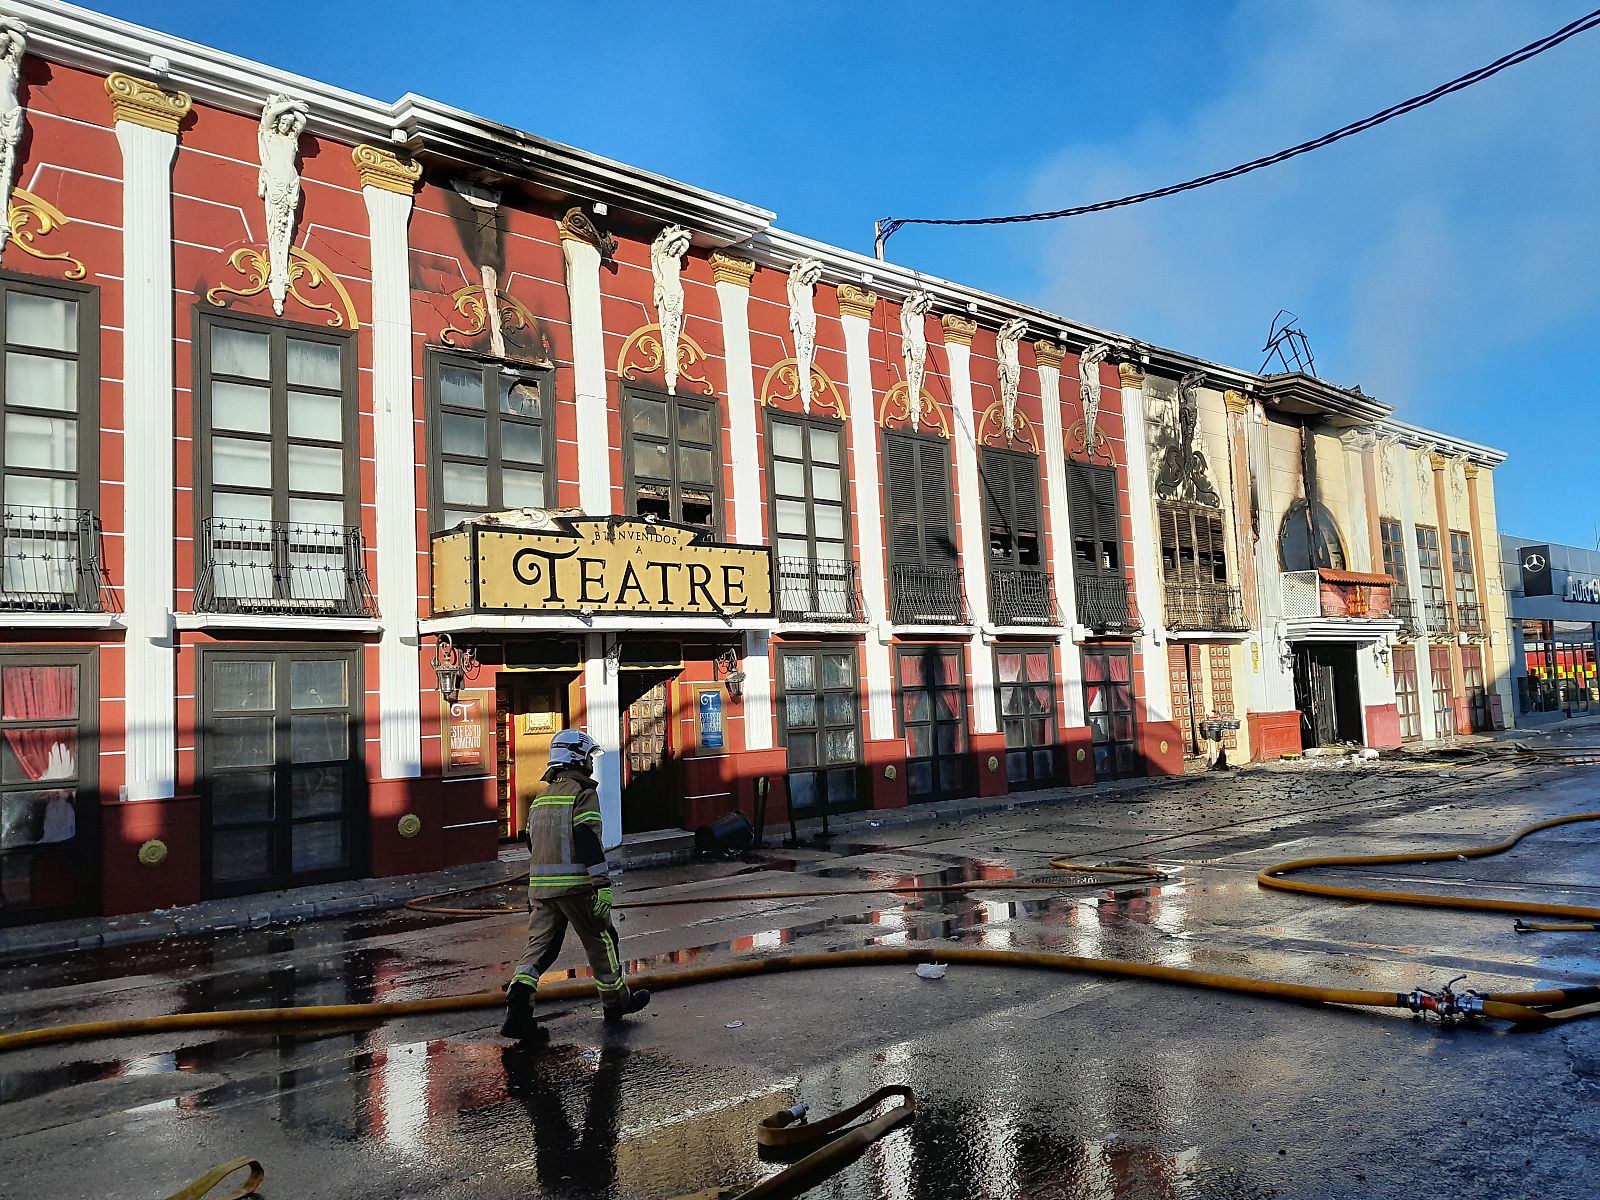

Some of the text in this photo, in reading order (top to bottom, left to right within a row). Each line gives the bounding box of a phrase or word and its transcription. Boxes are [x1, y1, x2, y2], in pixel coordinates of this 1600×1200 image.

[594, 530, 677, 546] BINVENIDOS
[635, 545, 643, 554] A
[512, 546, 748, 613] TEATRE
[464, 725, 472, 737] ES
[474, 724, 481, 737] TU
[451, 737, 480, 749] MOMENTO
